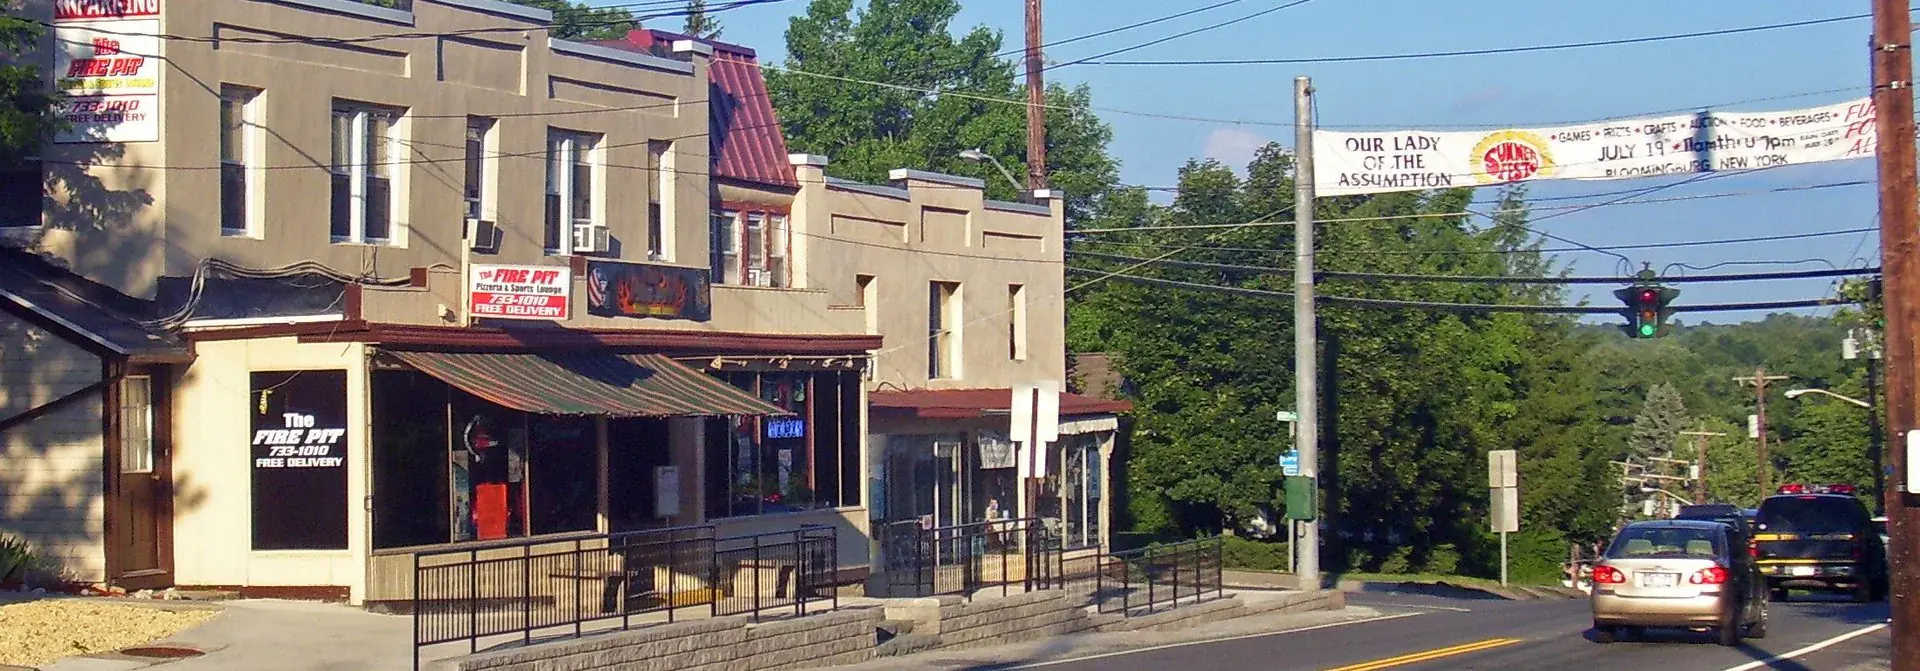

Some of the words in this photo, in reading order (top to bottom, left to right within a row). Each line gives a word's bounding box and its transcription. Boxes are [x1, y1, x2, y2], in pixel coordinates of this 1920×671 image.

[93, 37, 120, 55] The
[67, 58, 111, 77] FIRE
[109, 57, 145, 76] PIT
[72, 99, 139, 112] 733-1010
[1844, 102, 1876, 122] FU
[94, 112, 146, 123] DELIVERY
[1558, 129, 1591, 143] GAMES
[1643, 121, 1676, 136] CRAFTS
[1740, 117, 1767, 128] FOOD
[1779, 111, 1831, 127] BEVERAGES
[1844, 118, 1876, 139] FO
[1345, 137, 1385, 152] OUR
[1394, 135, 1440, 151] LADY
[1598, 144, 1636, 161] JULY
[1717, 134, 1756, 150] thru
[1759, 134, 1796, 151] 7pm
[1846, 137, 1873, 156] AL
[1363, 155, 1385, 170] OF
[1393, 153, 1425, 169] THE
[1719, 155, 1749, 170] NEW
[1755, 153, 1789, 169] YORK
[1338, 172, 1453, 188] ASSUMPTION
[493, 268, 530, 283] FIRE
[530, 270, 560, 284] PIT
[476, 282, 503, 292] Pizzeria
[510, 284, 534, 293] Sports
[536, 285, 562, 294] Lounge
[489, 293, 549, 306] 733-1010
[474, 303, 503, 313] FREE
[505, 304, 561, 316] DELIVERY
[283, 412, 315, 428] The
[252, 429, 304, 445] FIRE
[304, 428, 345, 444] PIT
[269, 445, 330, 456] 733-1010
[256, 457, 284, 468] FREE
[286, 456, 343, 467] DELIVERY
